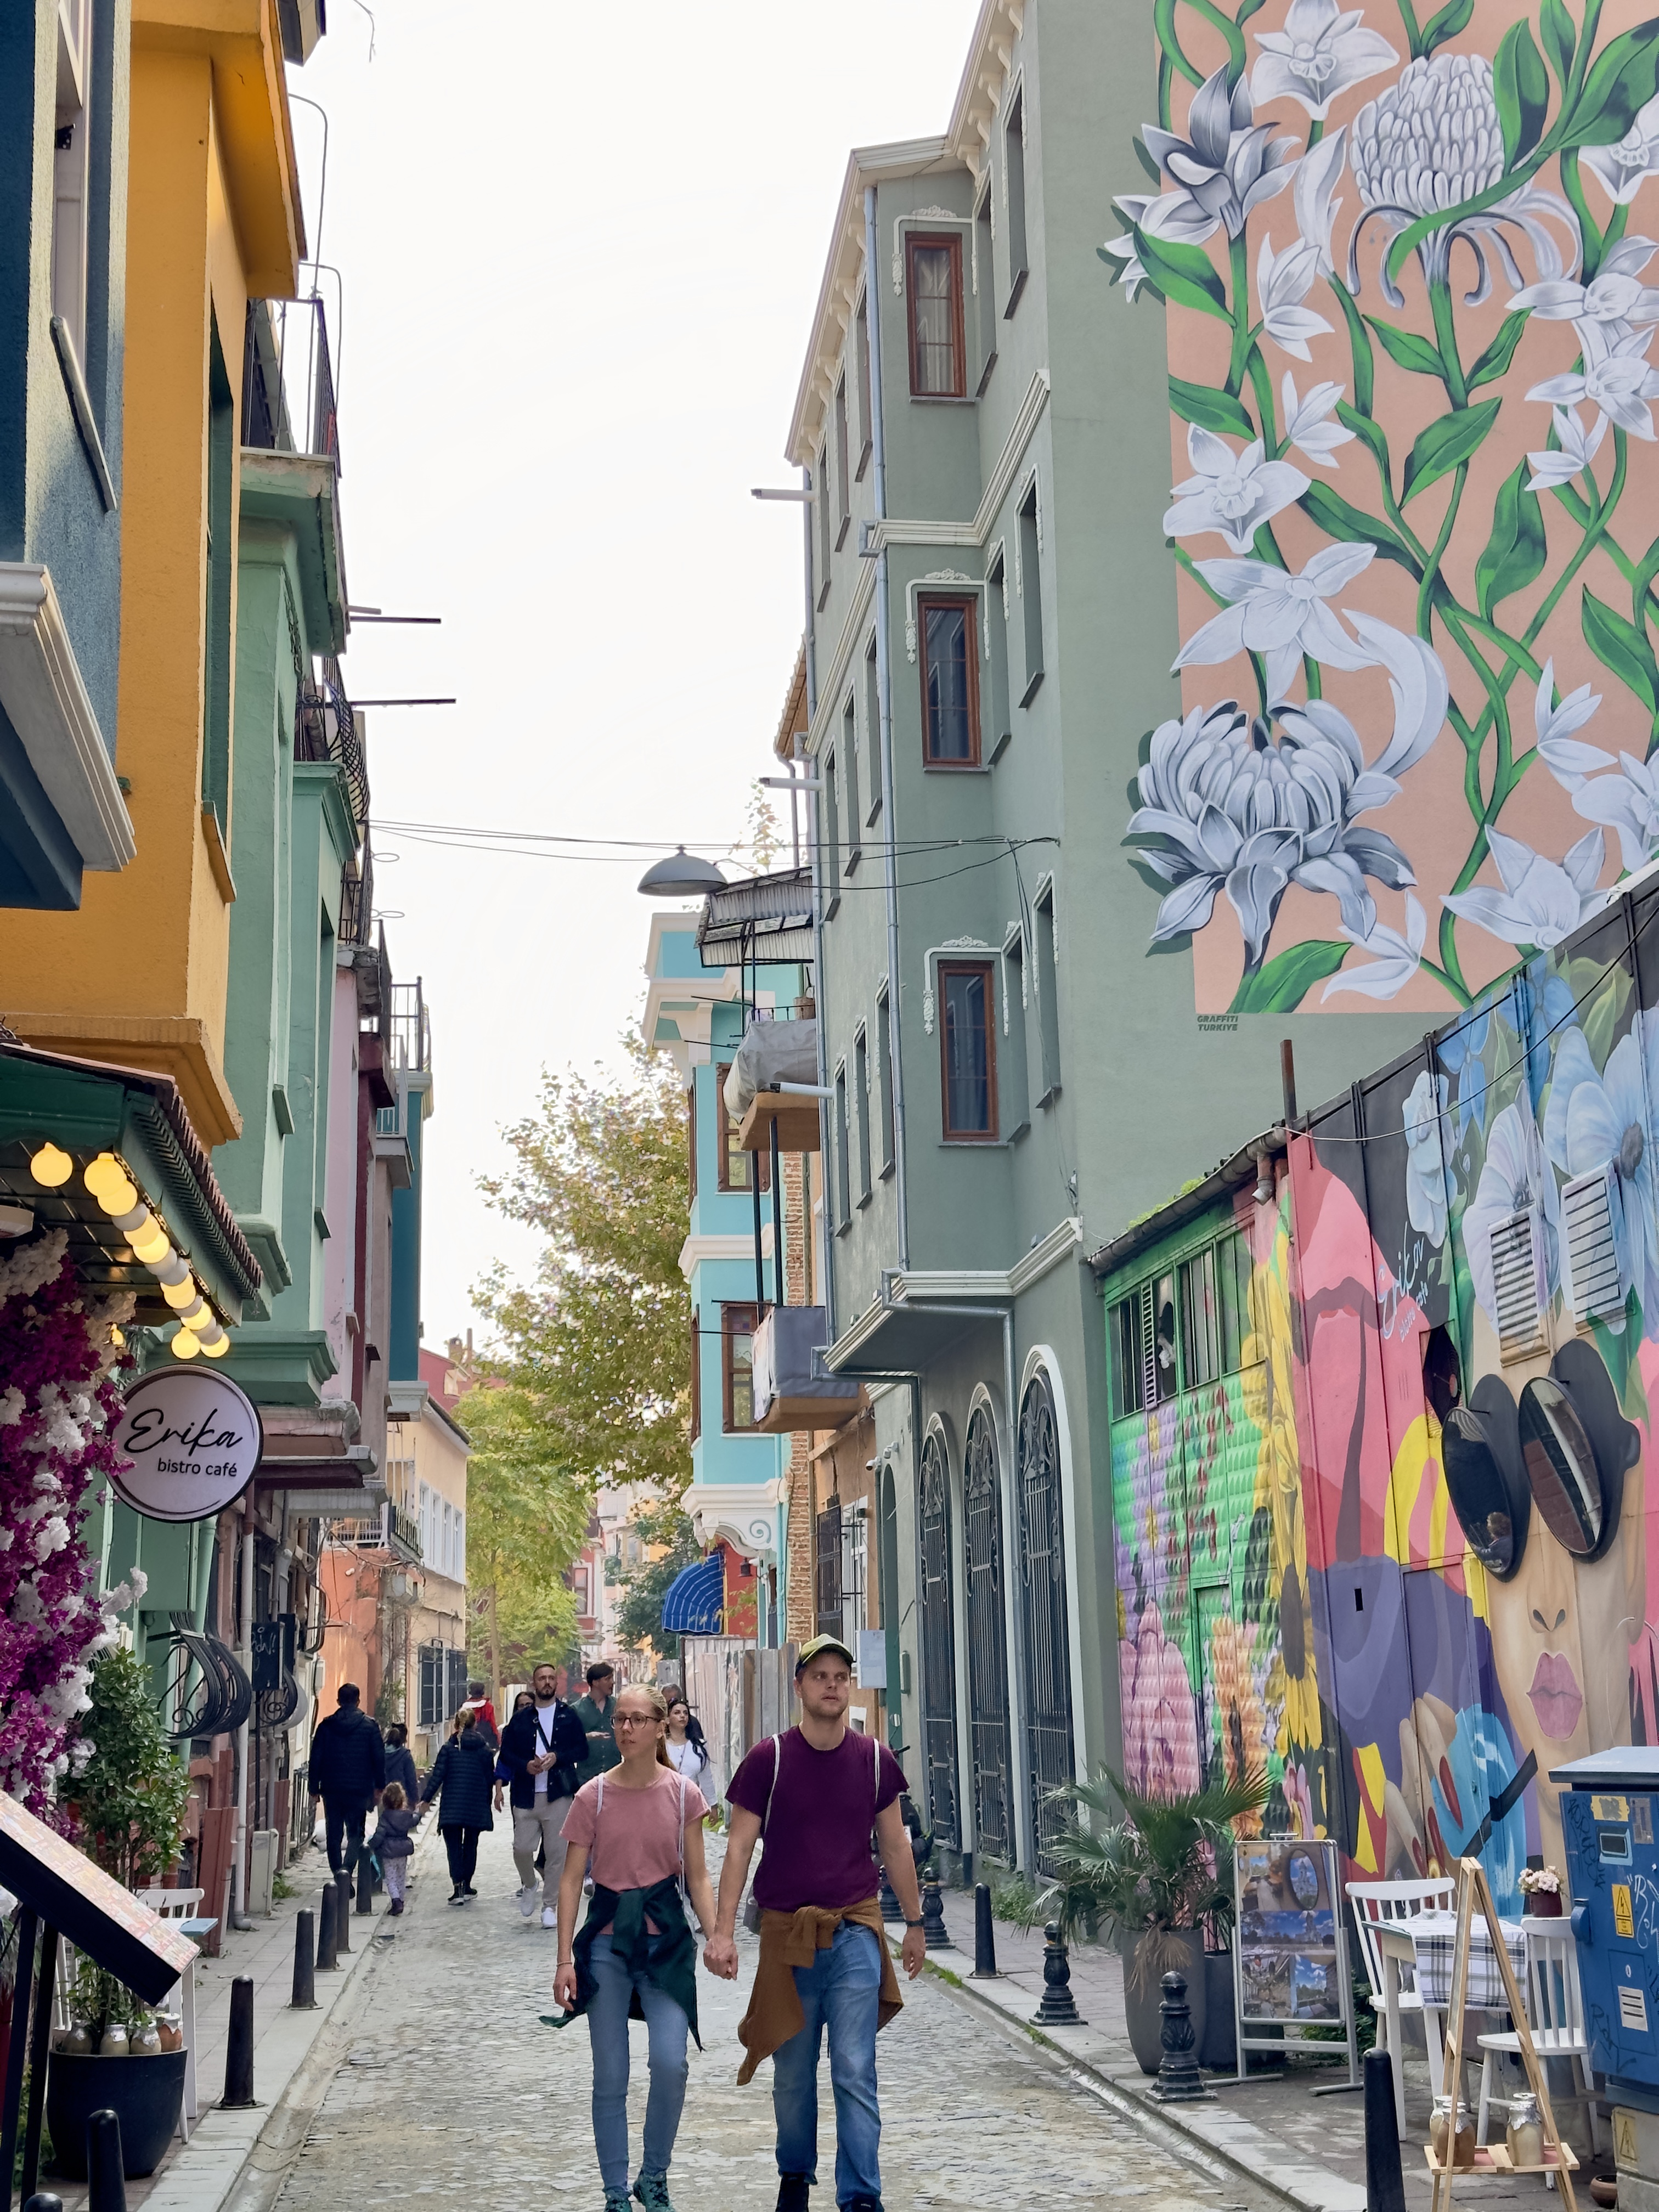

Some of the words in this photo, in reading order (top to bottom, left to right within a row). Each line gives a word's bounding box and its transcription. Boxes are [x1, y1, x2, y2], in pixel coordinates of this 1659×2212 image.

[124, 1408, 243, 1456] Erika
[157, 1457, 201, 1474] bistro
[206, 1462, 238, 1477] café
